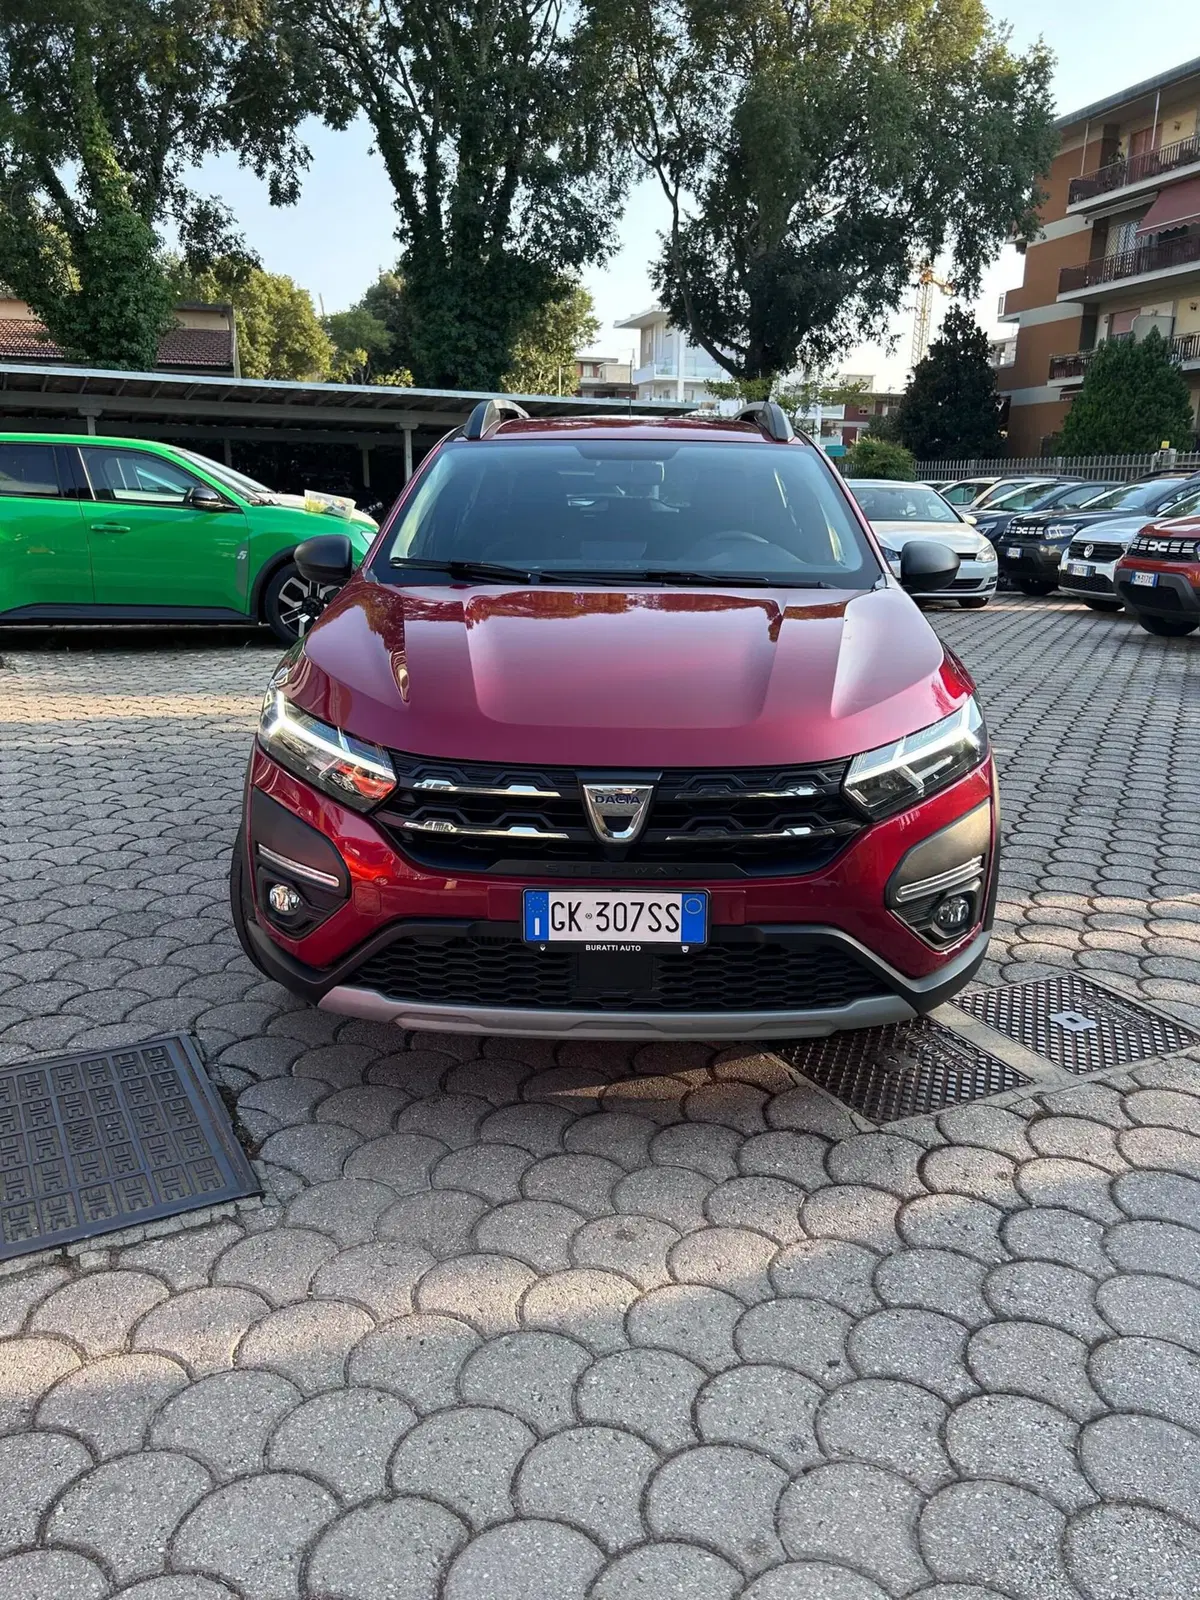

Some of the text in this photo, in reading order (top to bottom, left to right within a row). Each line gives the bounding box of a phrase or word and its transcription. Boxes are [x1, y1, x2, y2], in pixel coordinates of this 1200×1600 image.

[595, 795, 640, 804] DACIA
[545, 863, 684, 876] STEPWAY
[551, 901, 582, 932] GK
[595, 901, 680, 933] 307SS
[585, 944, 641, 952] BURATTI AUTO
